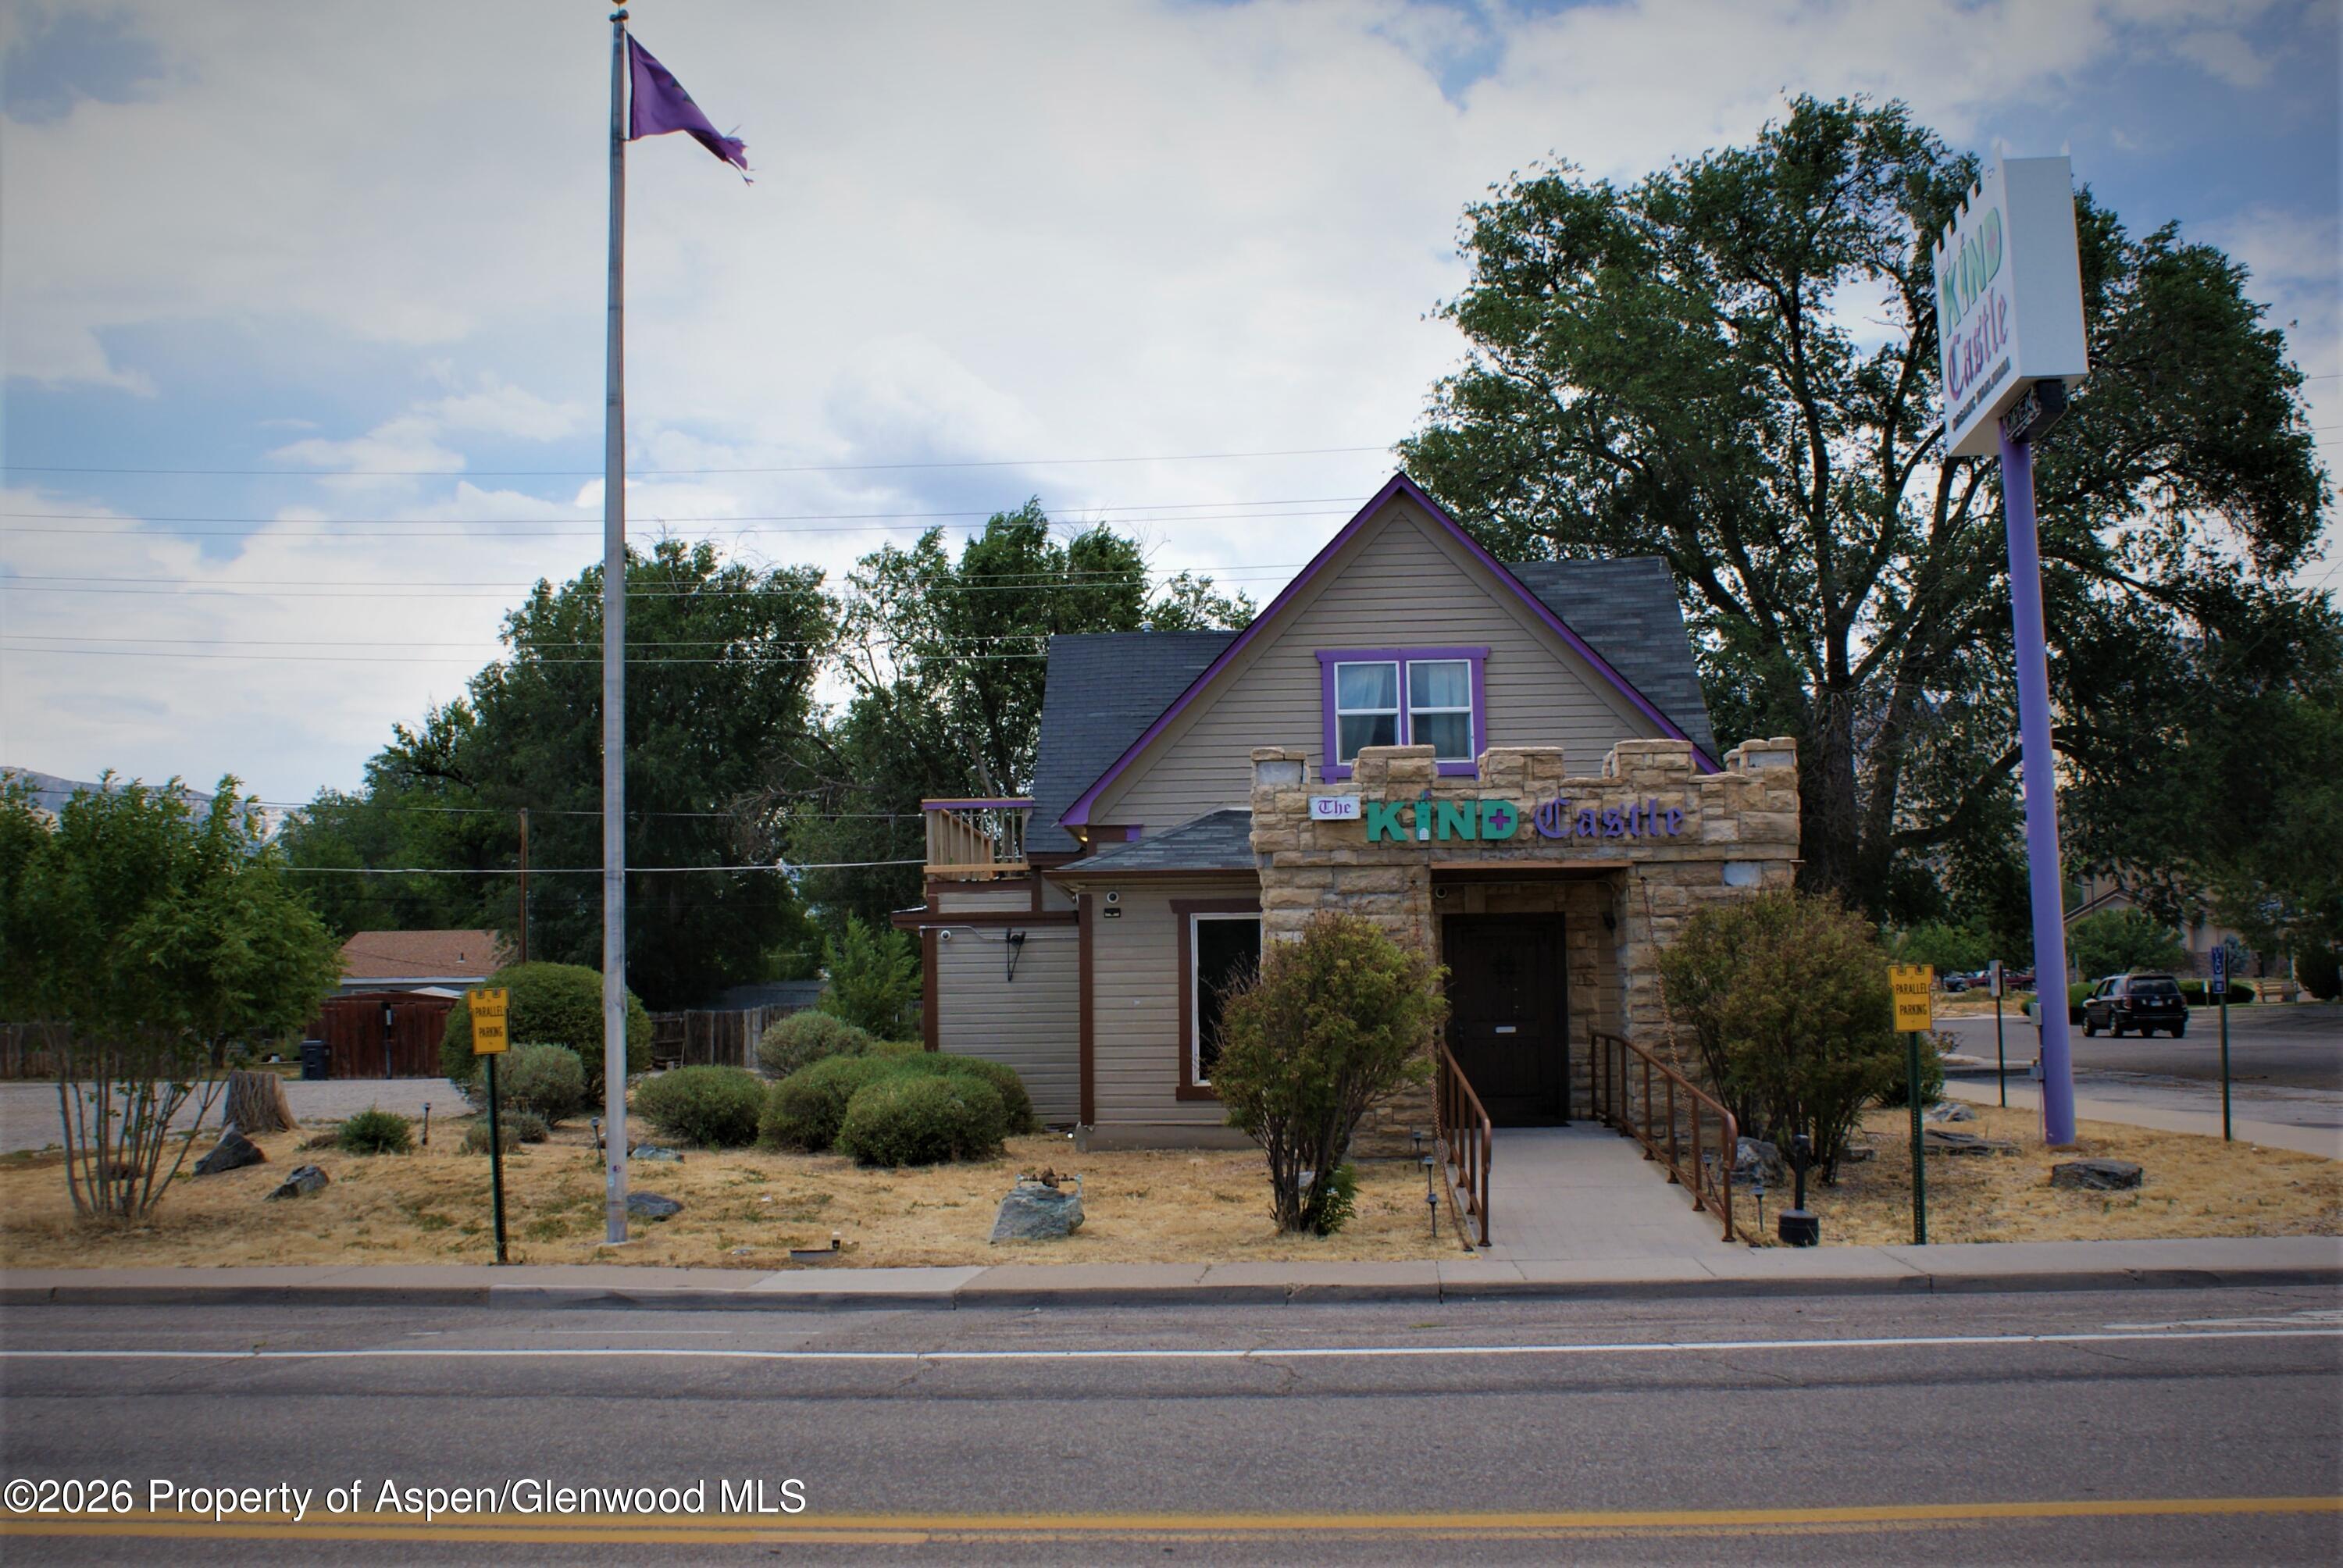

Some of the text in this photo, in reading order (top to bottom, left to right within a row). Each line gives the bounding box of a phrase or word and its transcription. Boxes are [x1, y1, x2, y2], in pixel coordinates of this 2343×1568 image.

[1948, 287, 2008, 401] Castle
[1318, 800, 1352, 815] The
[1535, 797, 1683, 839] Castle
[1895, 983, 1928, 994] PARALLEL
[475, 1006, 504, 1017] PARALLEL
[1899, 1004, 1928, 1015] PARKING
[479, 1026, 504, 1038] PARKING
